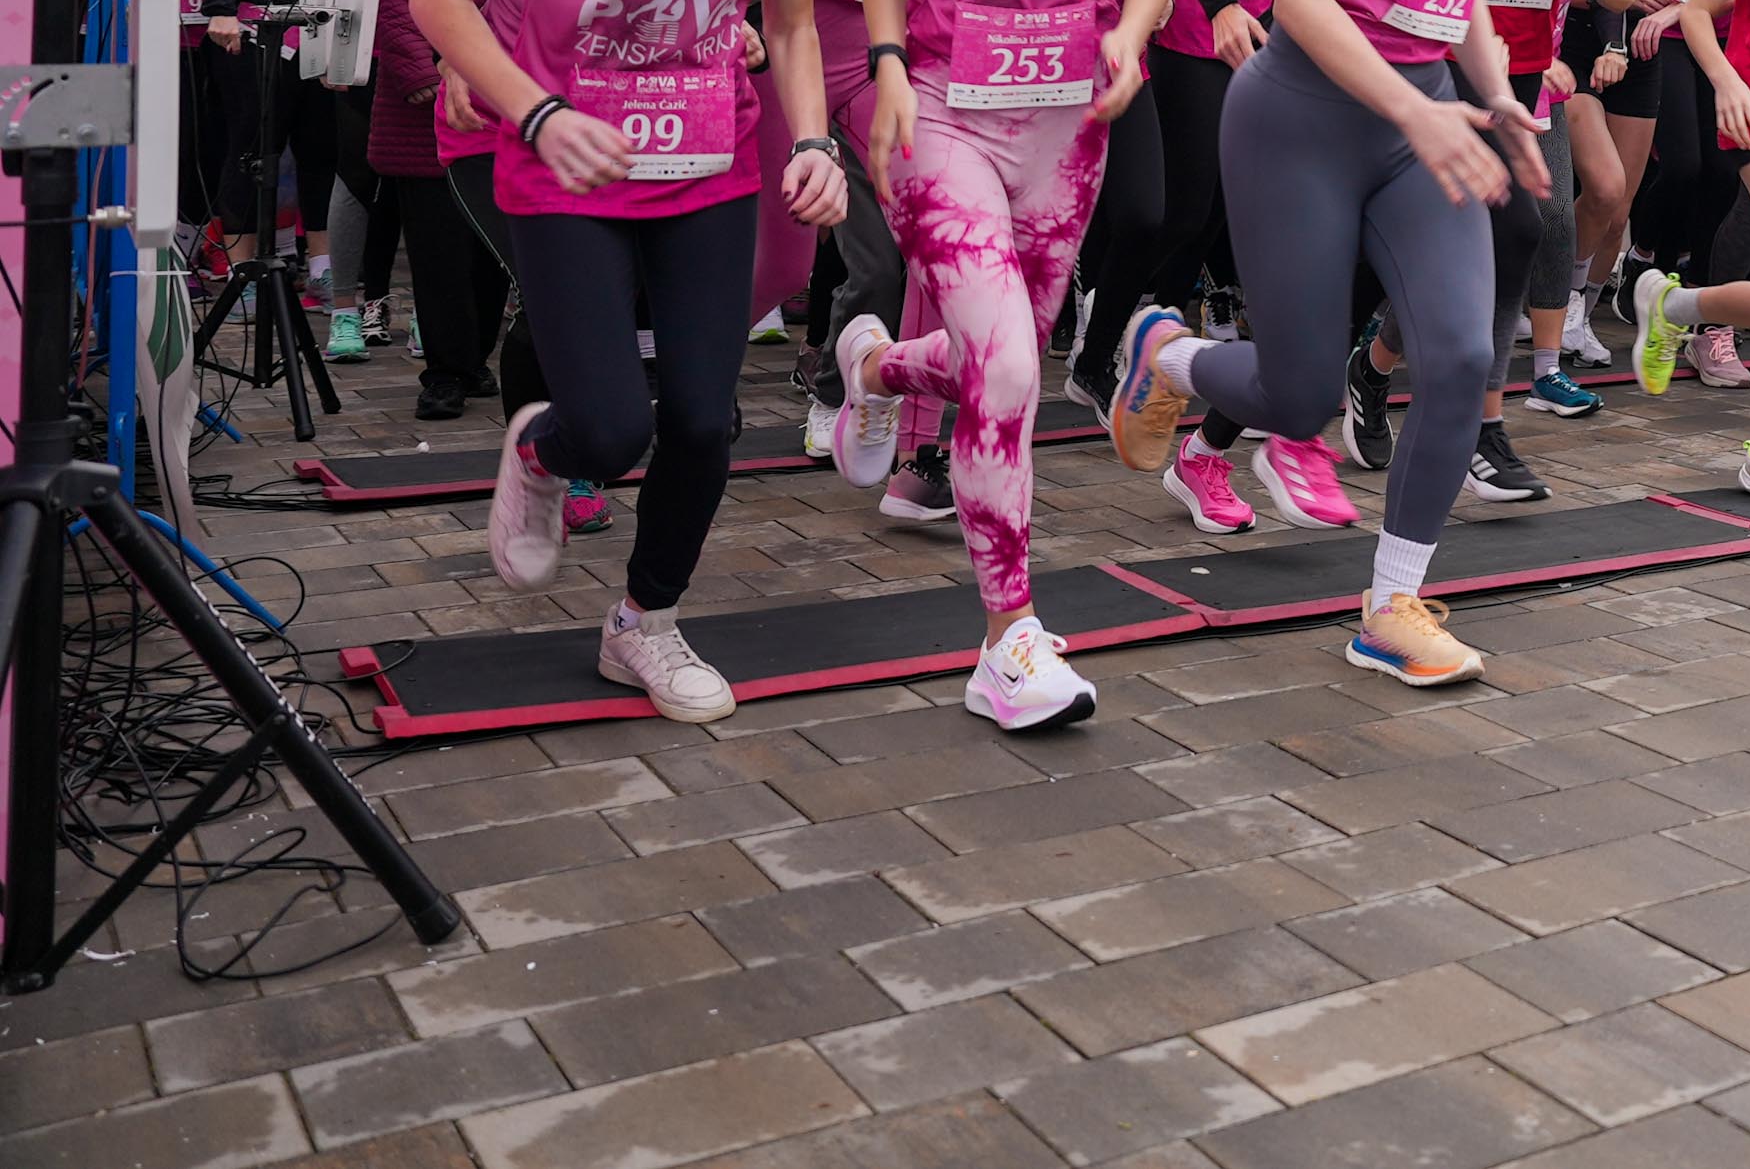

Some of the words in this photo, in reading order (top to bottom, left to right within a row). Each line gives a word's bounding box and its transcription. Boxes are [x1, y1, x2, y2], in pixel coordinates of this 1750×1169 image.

[574, 25, 684, 65] ŽENSKA
[694, 23, 744, 63] TRKA
[988, 46, 1064, 83] 253
[622, 113, 684, 152] 99
